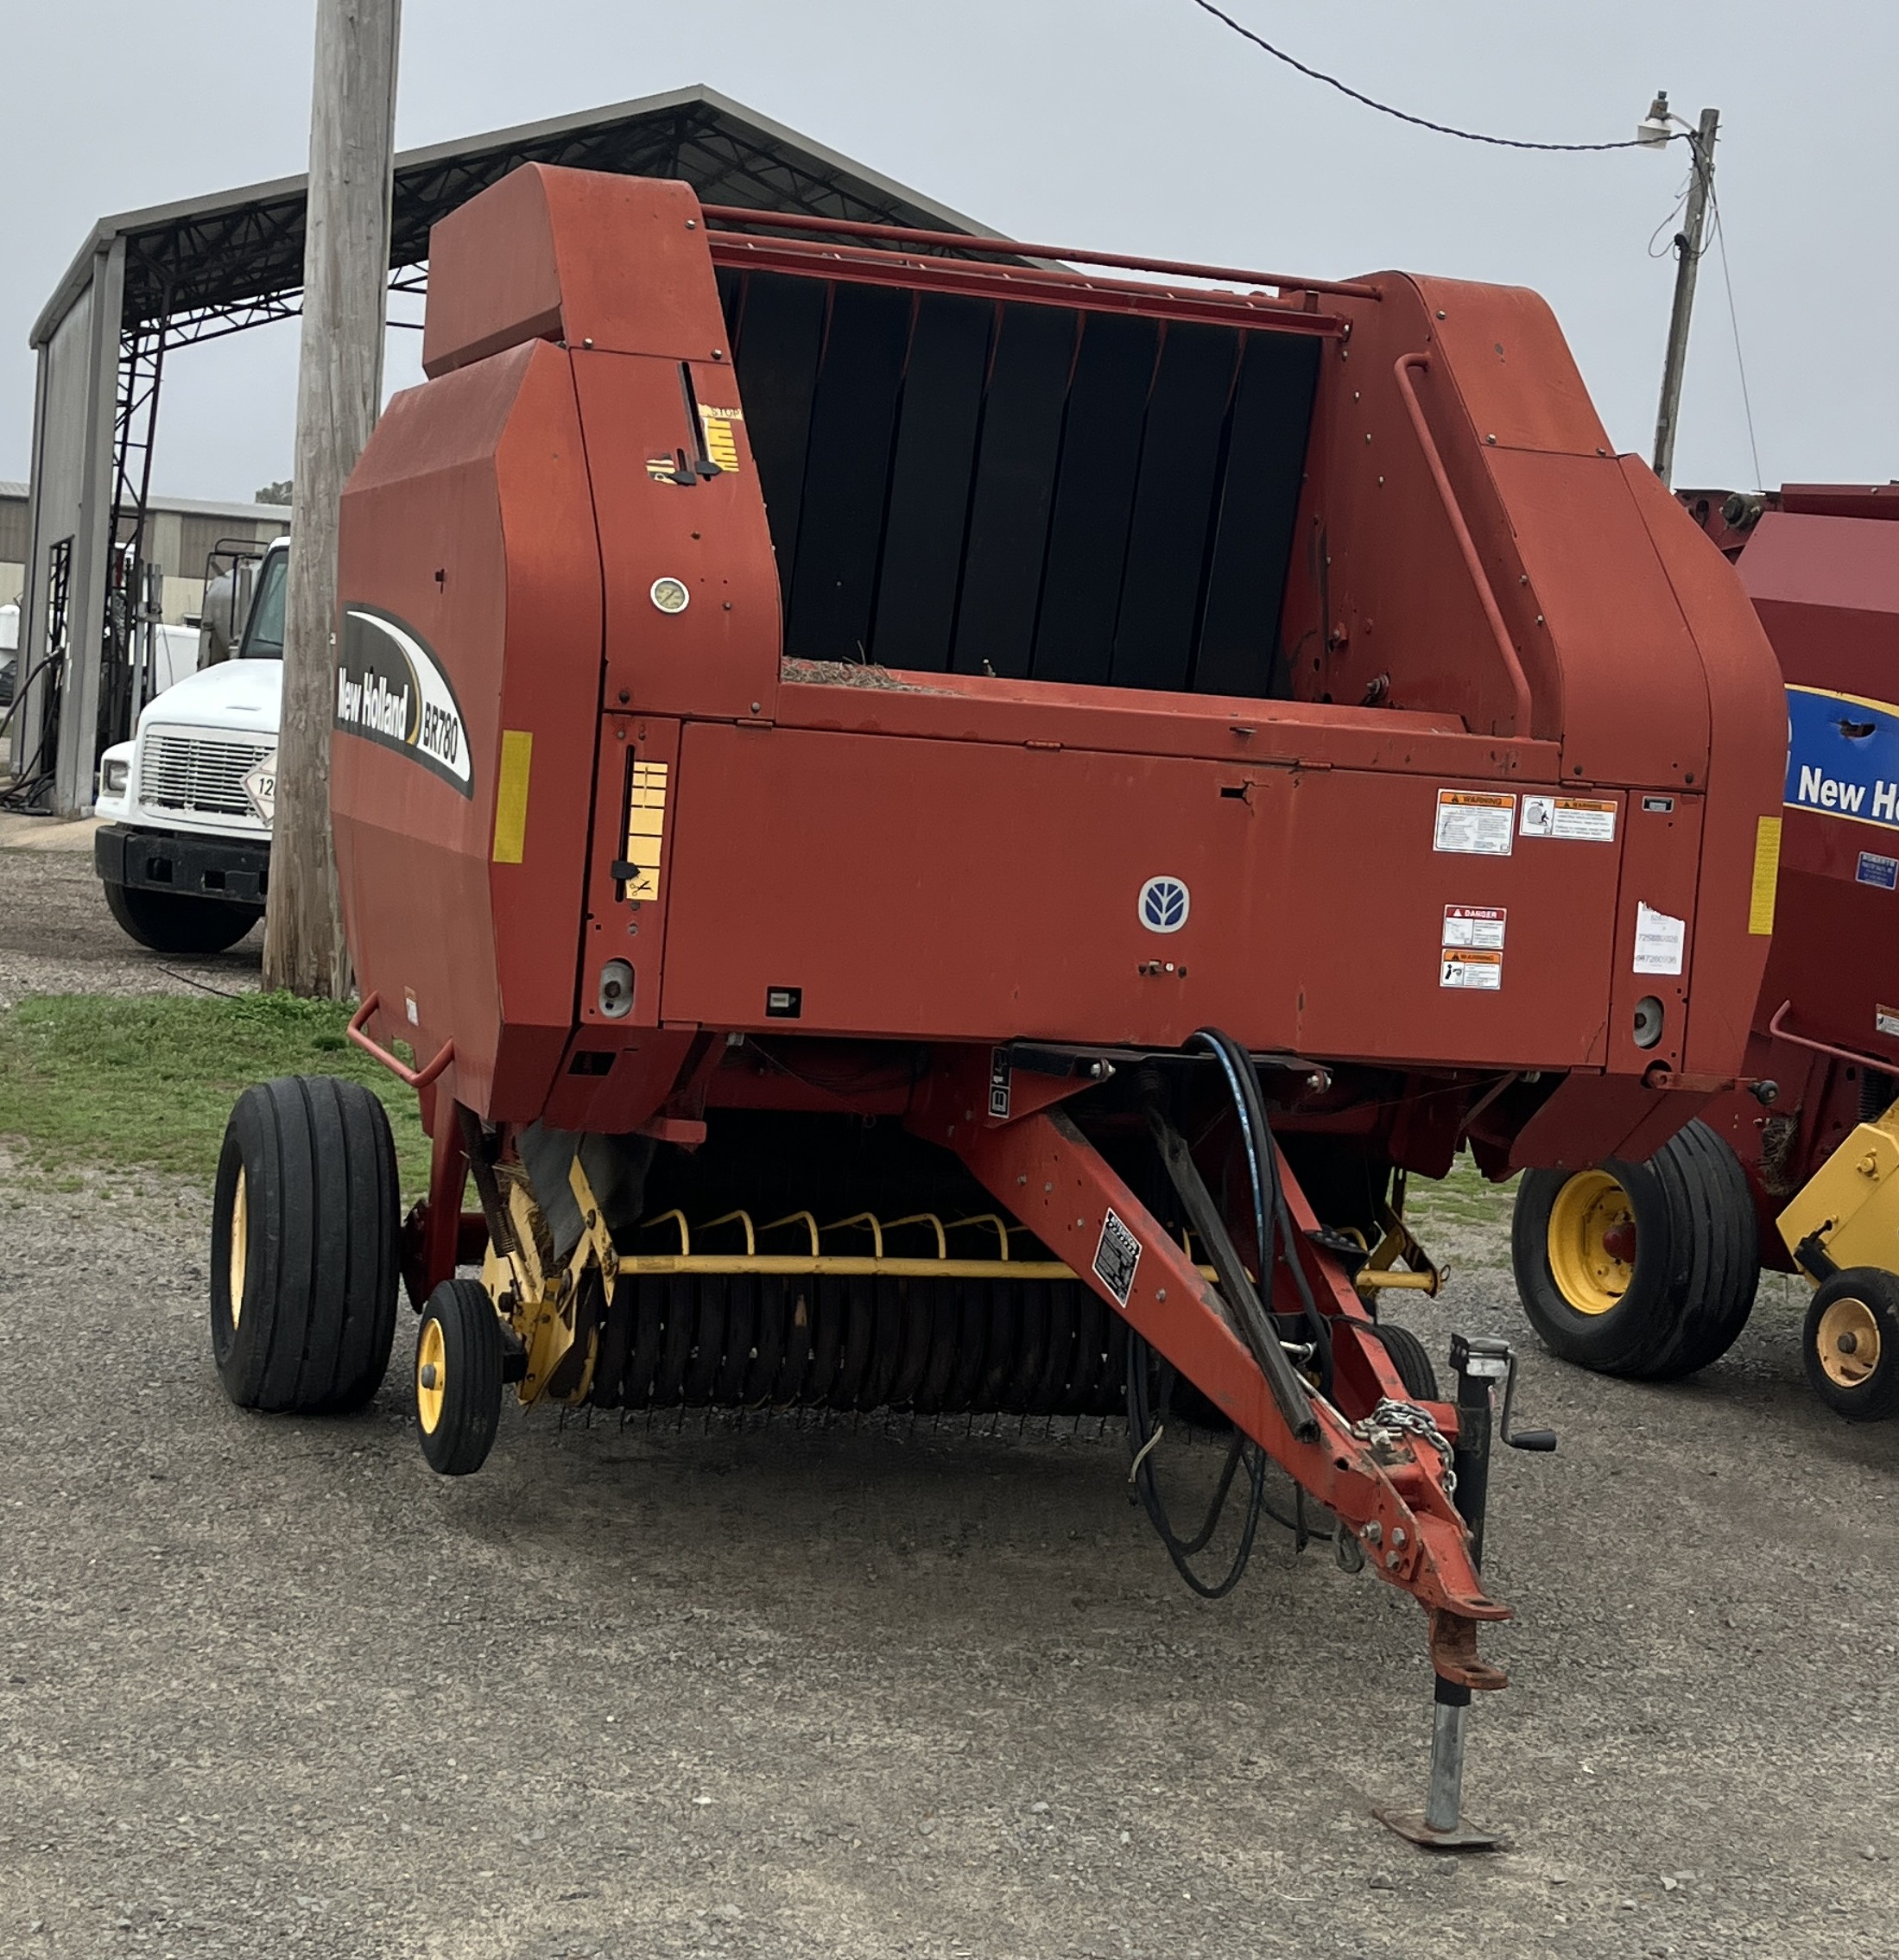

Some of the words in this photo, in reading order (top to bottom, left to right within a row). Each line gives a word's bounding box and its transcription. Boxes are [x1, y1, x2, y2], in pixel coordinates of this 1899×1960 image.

[712, 408, 739, 416] STOP
[338, 667, 362, 723] New
[362, 672, 408, 741] Holland
[423, 701, 458, 764] BR780
[259, 777, 276, 796] 12
[1798, 765, 1866, 812] New
[1871, 780, 1899, 821] H
[1463, 795, 1503, 806] WARNING
[1464, 909, 1497, 919] DANGER
